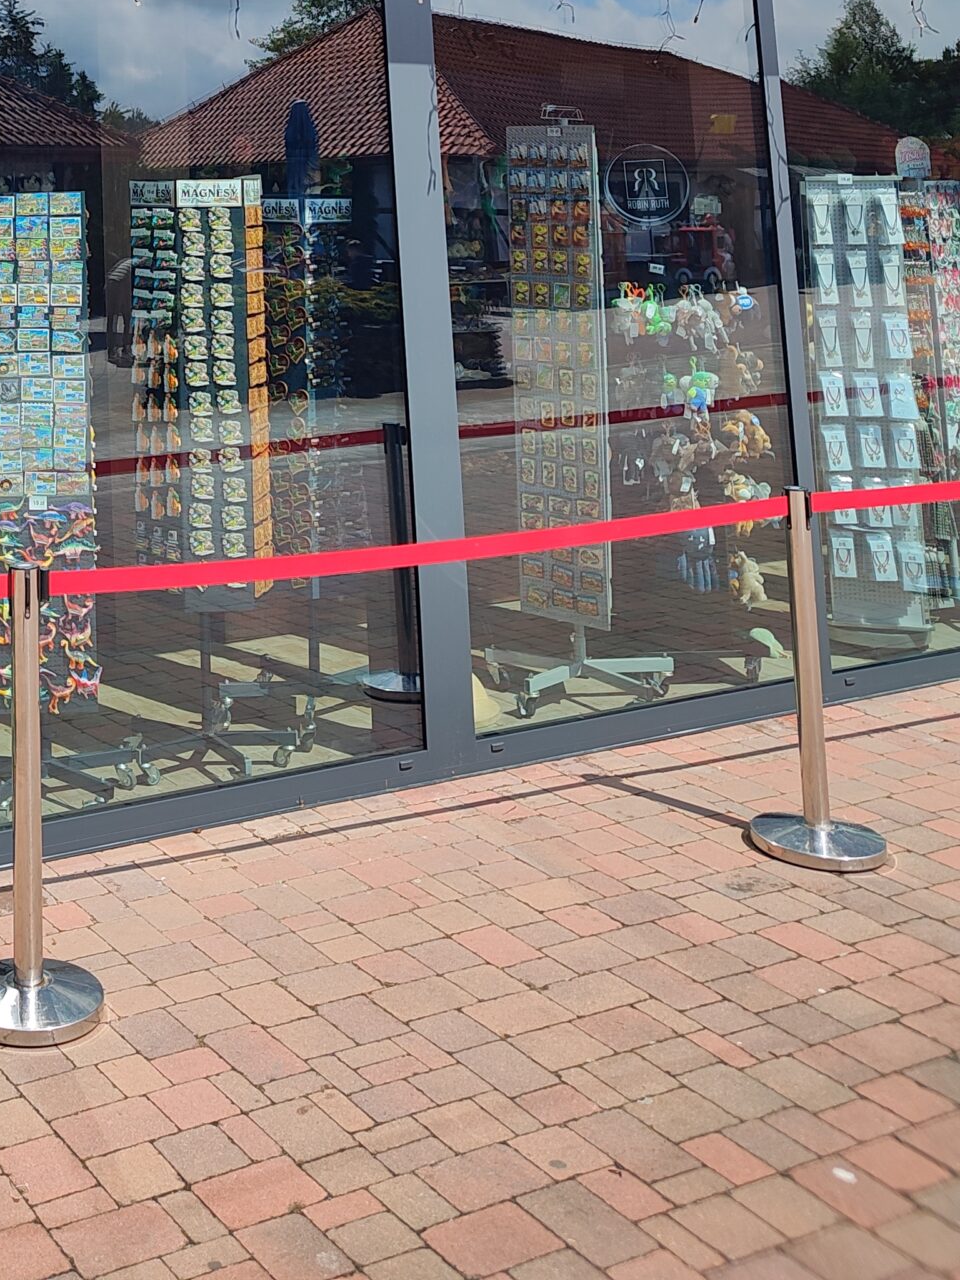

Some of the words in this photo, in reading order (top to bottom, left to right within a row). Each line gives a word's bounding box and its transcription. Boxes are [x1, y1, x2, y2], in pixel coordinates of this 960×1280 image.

[132, 188, 172, 198] MAESY
[181, 189, 239, 198] MAGNESY
[628, 200, 649, 209] ROBIN
[651, 200, 670, 208] RUTH
[262, 205, 297, 215] GNESY
[307, 205, 351, 215] MAGNES
